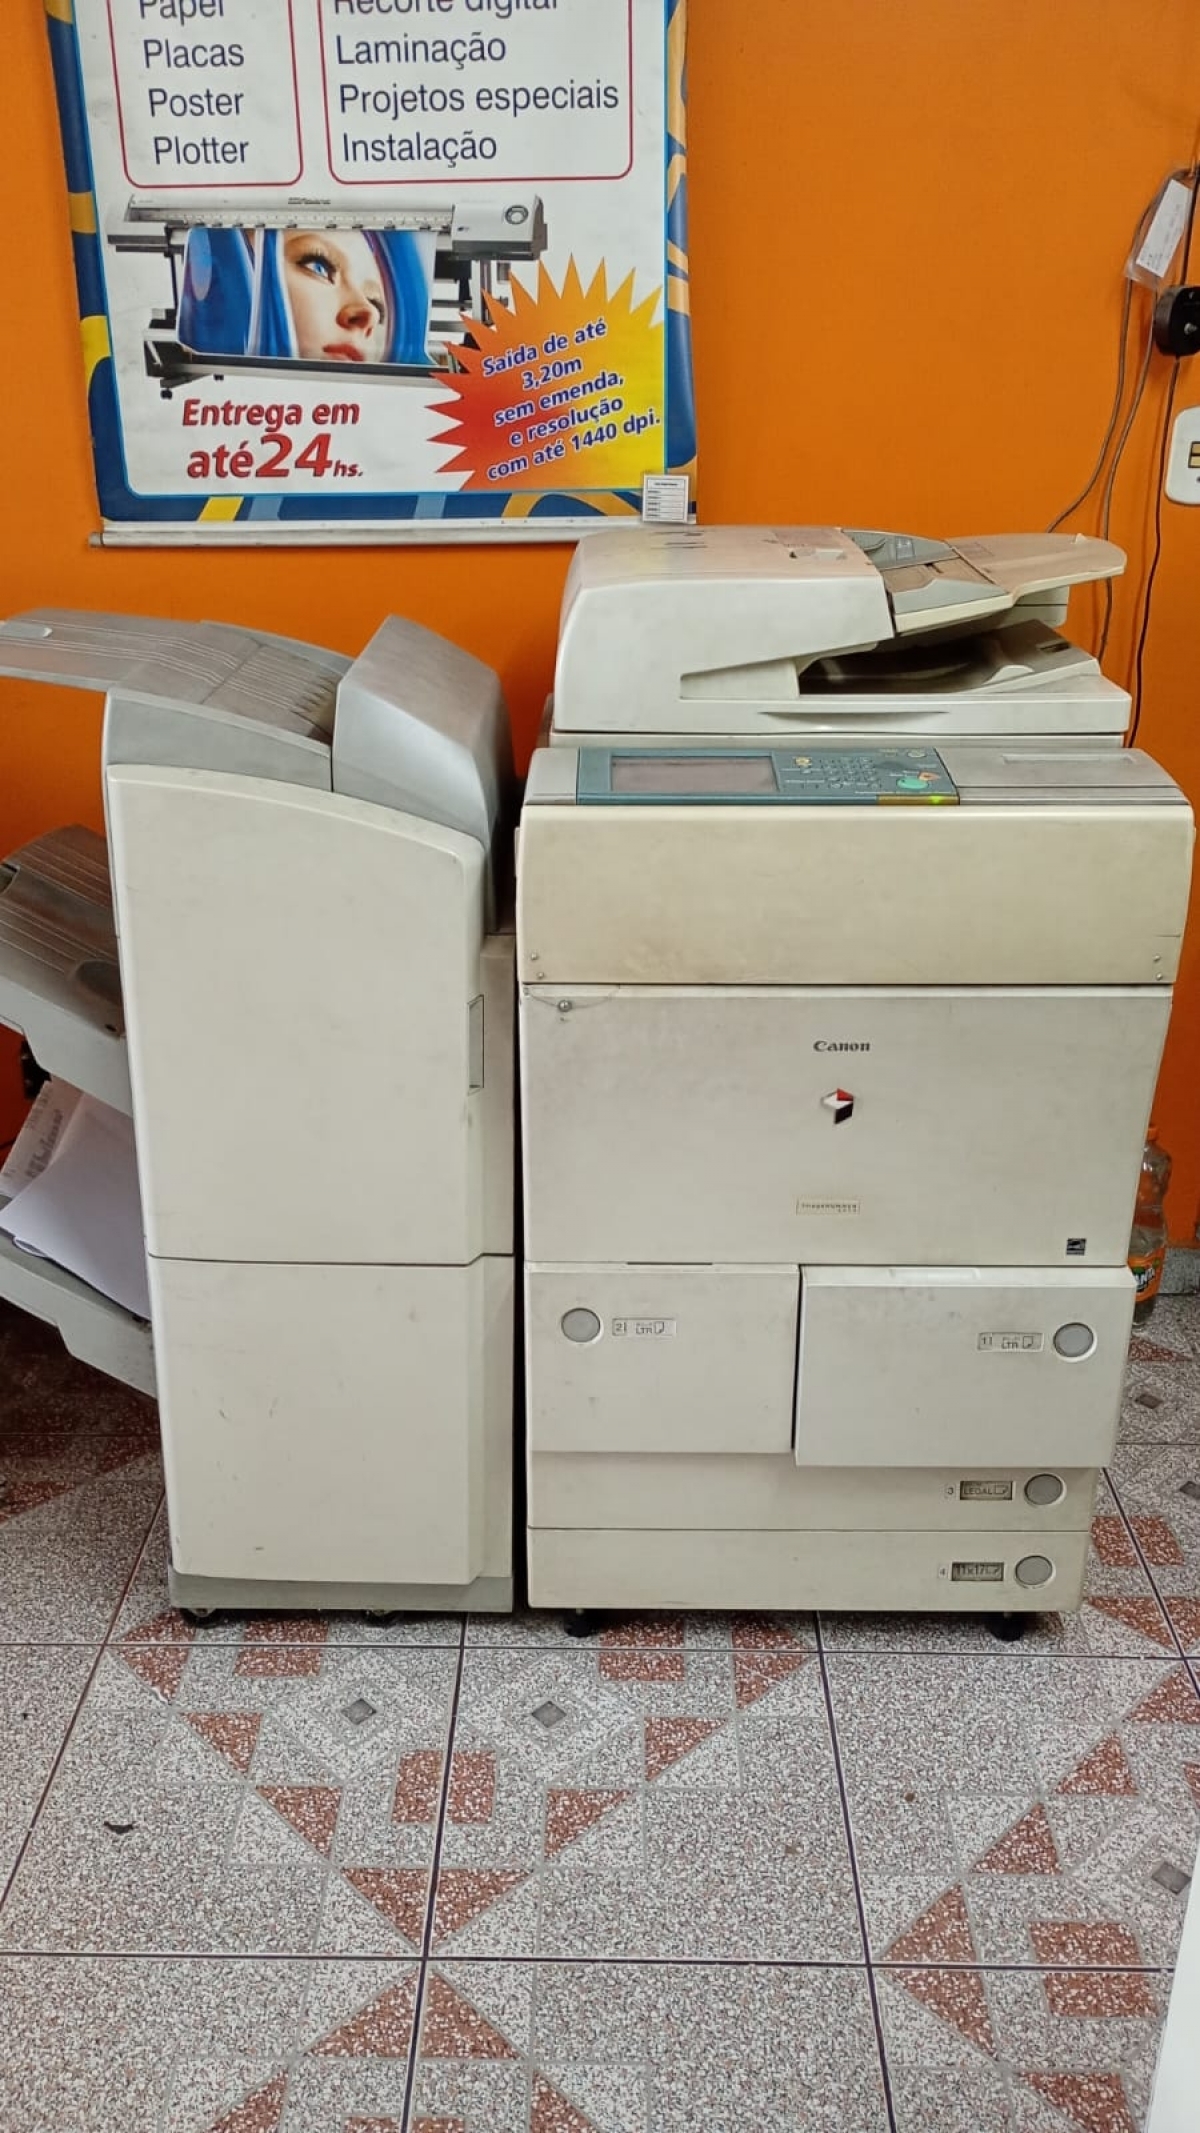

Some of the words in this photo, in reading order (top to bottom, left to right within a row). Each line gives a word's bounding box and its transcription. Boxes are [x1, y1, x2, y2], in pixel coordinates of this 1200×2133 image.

[139, 0, 224, 26] Papel
[143, 39, 245, 69] Placas
[336, 32, 507, 70] Laminação
[148, 88, 244, 118] Poster
[339, 83, 465, 120] Projetos
[475, 79, 620, 117] especiais
[153, 136, 249, 165] Plotter
[343, 130, 498, 168] Instalação
[543, 335, 568, 355] de
[574, 317, 607, 345] até
[522, 358, 582, 390] 3,20m
[182, 398, 303, 433] Entrega
[311, 402, 360, 425] em
[494, 401, 534, 426] sem
[539, 371, 624, 409] emenda,
[510, 432, 522, 446] e
[527, 398, 624, 442] resolução
[487, 456, 528, 480] com
[533, 440, 565, 465] até
[571, 423, 617, 451] 1440
[623, 408, 661, 434] dpi.
[813, 1040, 870, 1052] Canon
